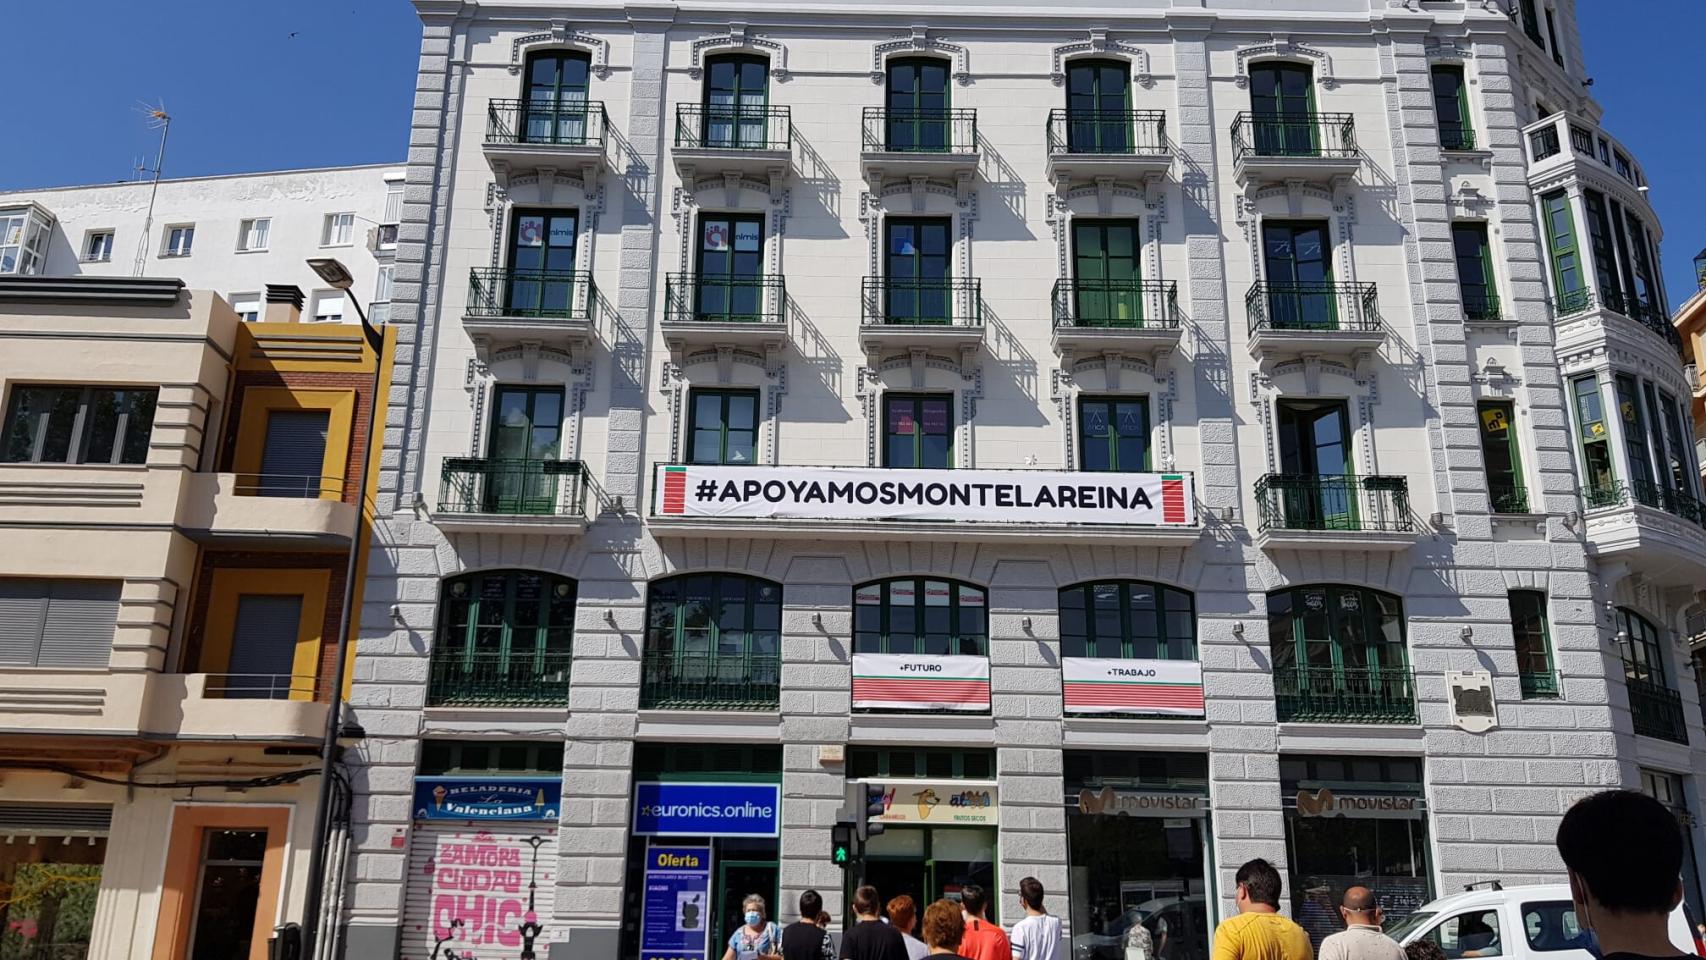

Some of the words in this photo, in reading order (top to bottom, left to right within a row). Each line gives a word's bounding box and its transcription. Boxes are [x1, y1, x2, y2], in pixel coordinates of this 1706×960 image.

[695, 480, 1153, 509] #APOYAMOSMONTELAREINA
[900, 664, 942, 672] +FUTURO
[1107, 668, 1156, 677] +TRABAJO
[446, 803, 532, 815] Valenciana
[651, 801, 772, 818] euronics.online
[1120, 795, 1198, 810] movistar
[1340, 796, 1416, 810] movistar
[439, 843, 521, 867] ZAMORA
[657, 853, 699, 867] Oferta
[437, 867, 522, 893] CIUDAD
[432, 894, 522, 947] CHIC
